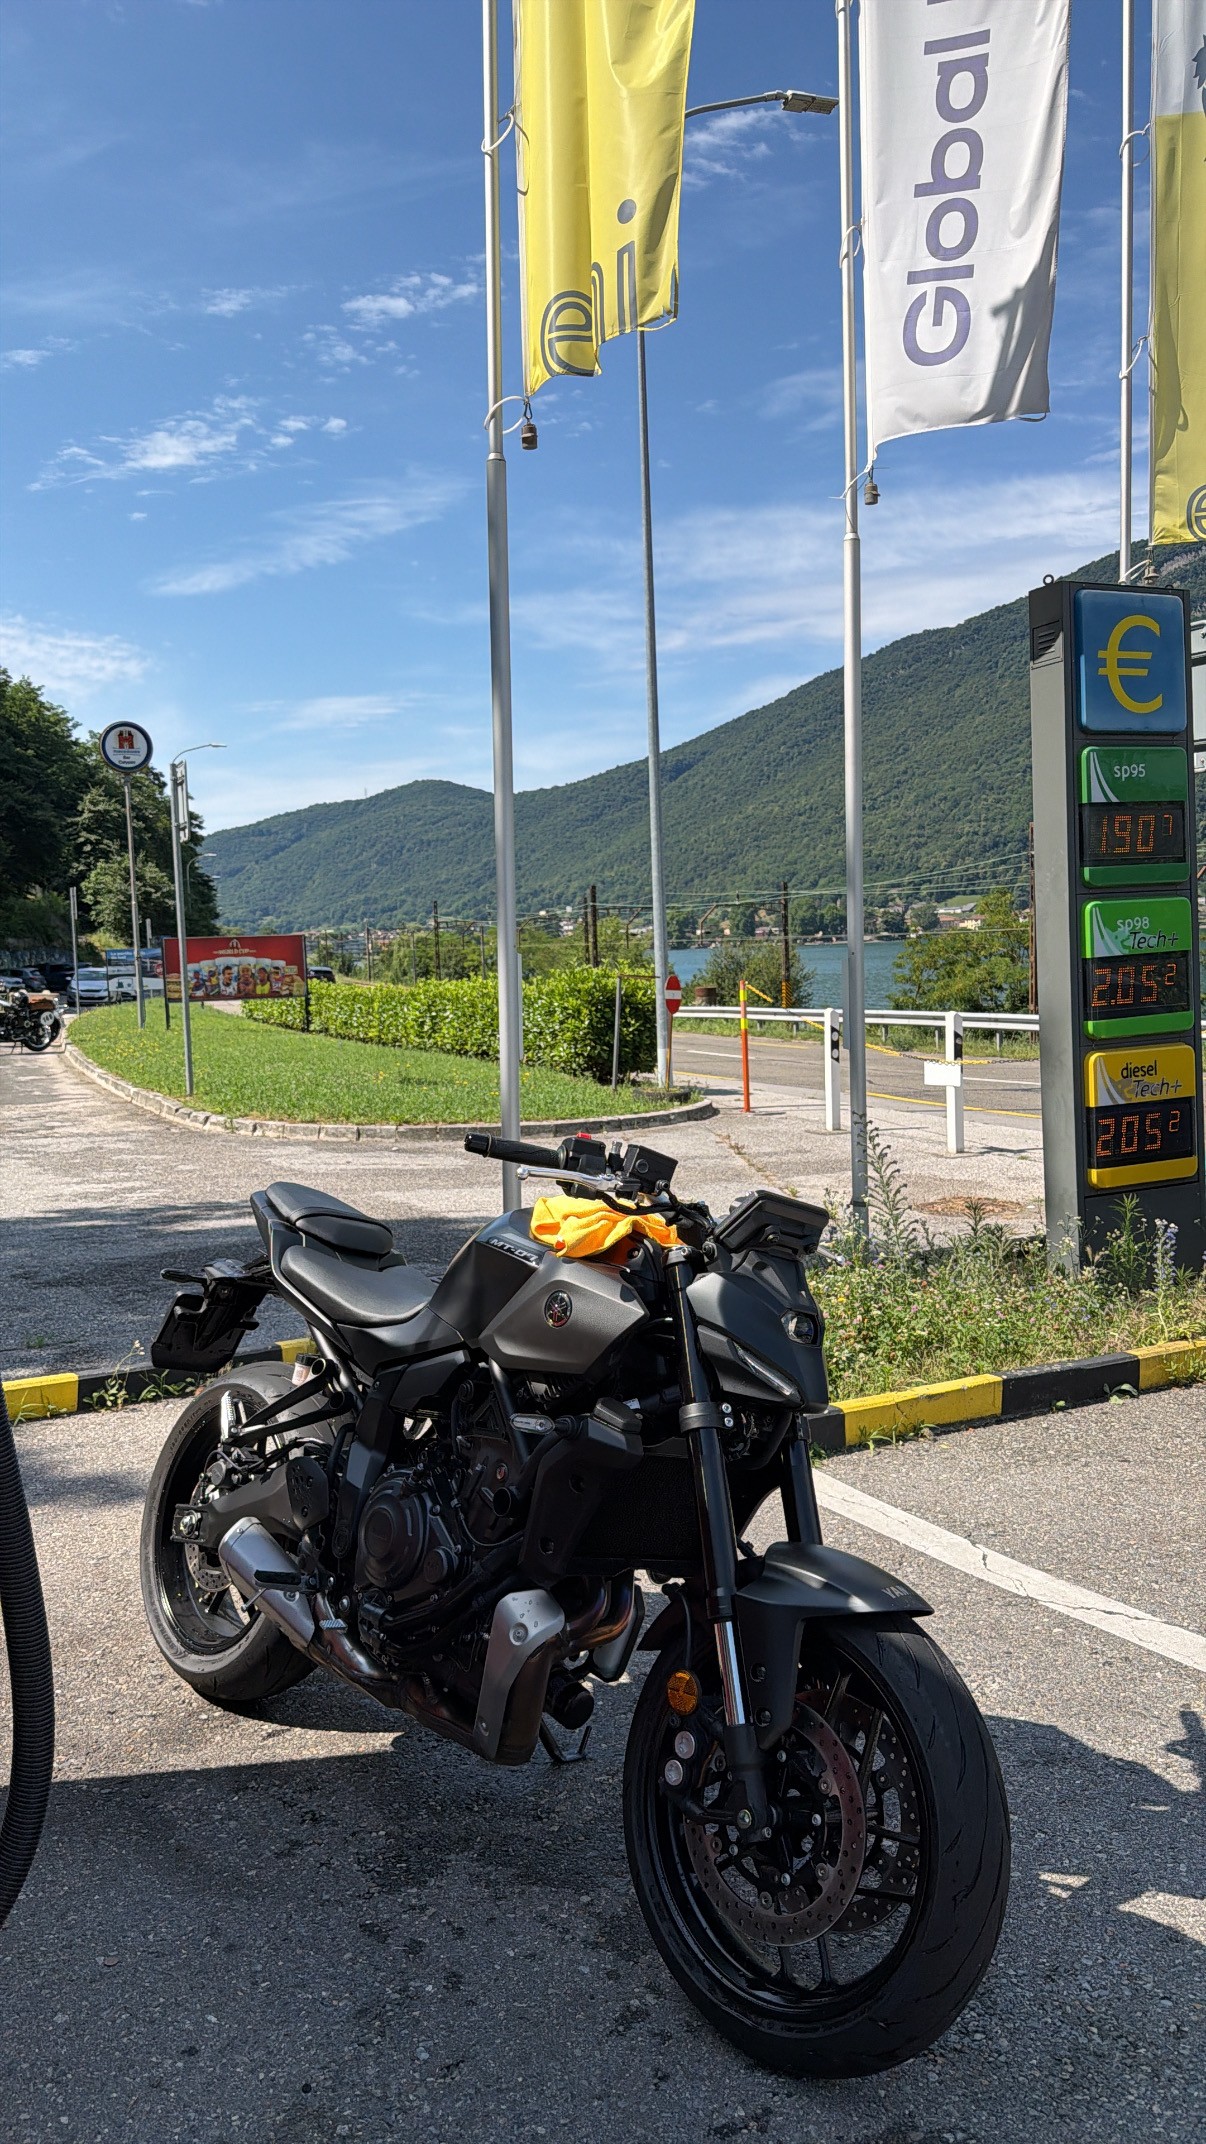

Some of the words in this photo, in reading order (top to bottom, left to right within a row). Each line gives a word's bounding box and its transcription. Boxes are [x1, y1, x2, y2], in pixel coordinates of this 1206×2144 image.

[902, 28, 991, 367] Global
[1113, 763, 1146, 782] sp95
[1116, 916, 1150, 932] sp98
[1130, 929, 1179, 950] Tech+
[1120, 1060, 1158, 1079] diesel
[1133, 1078, 1182, 1099] Tech+
[490, 1239, 539, 1261] MT-07
